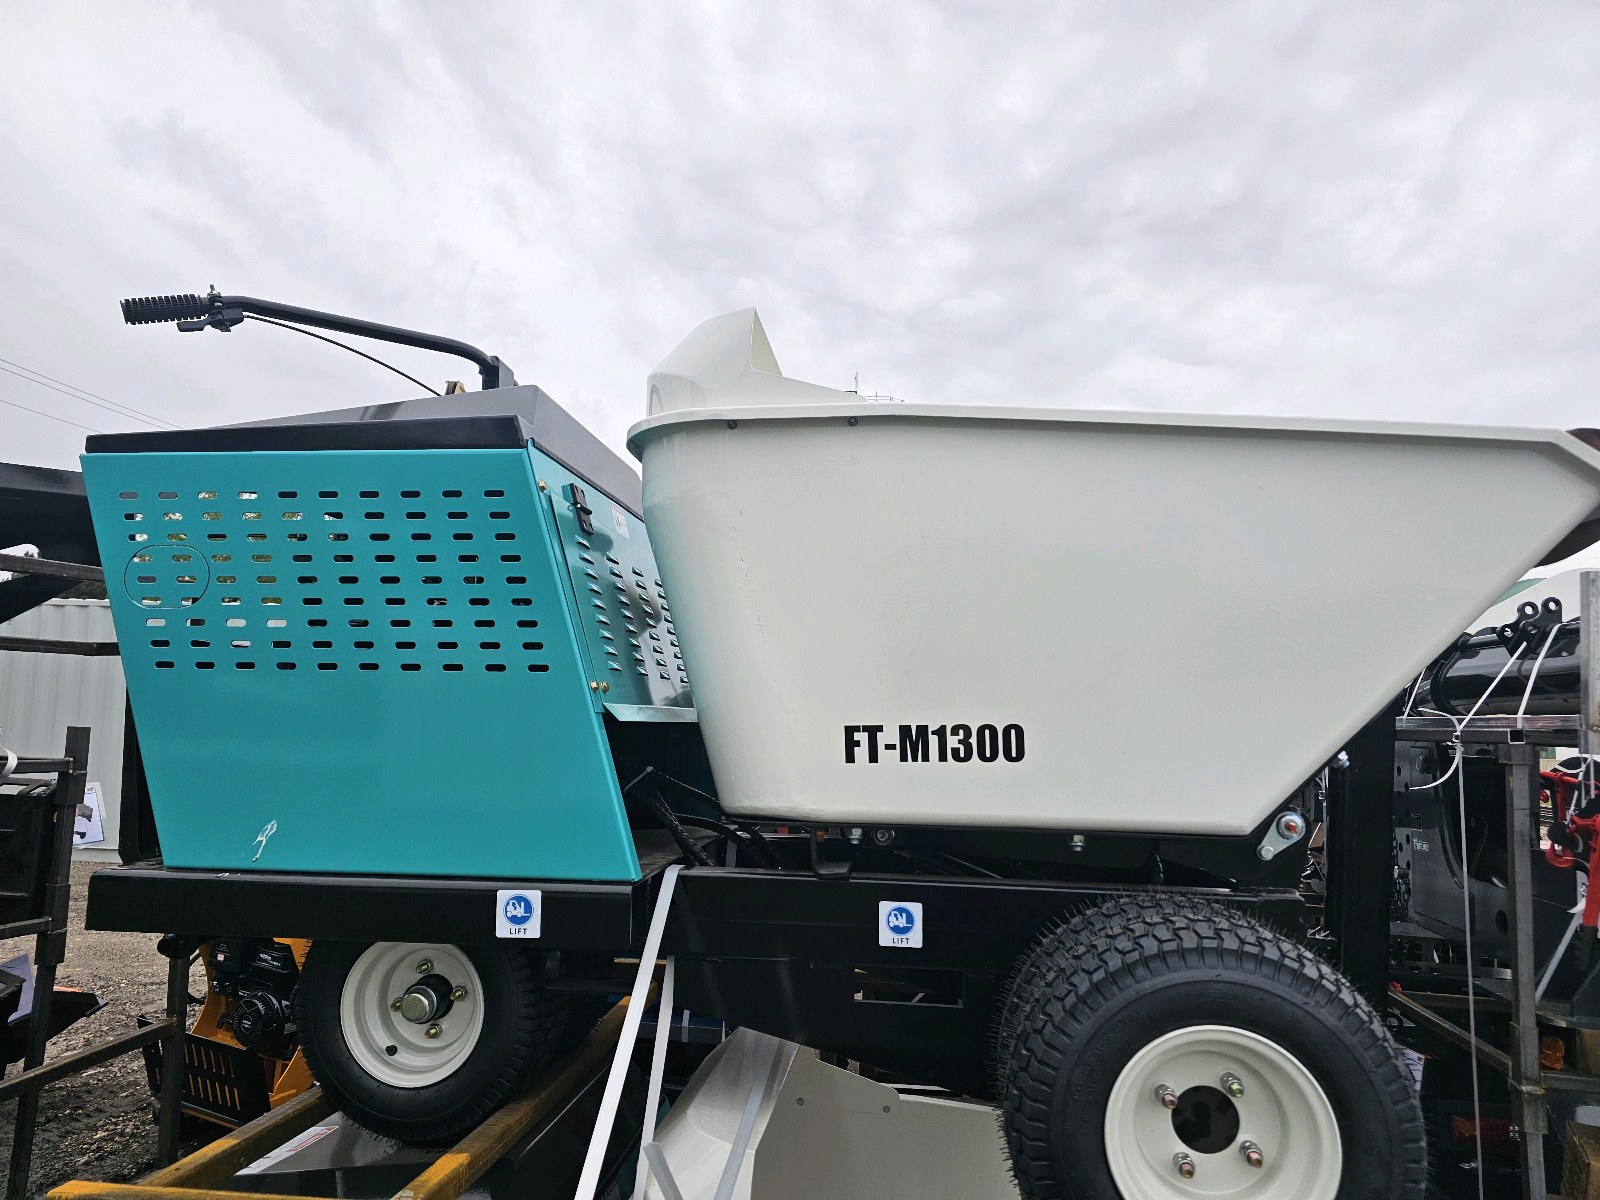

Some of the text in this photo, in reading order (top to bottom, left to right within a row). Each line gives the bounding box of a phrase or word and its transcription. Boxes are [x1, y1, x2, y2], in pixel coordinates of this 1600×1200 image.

[844, 723, 1025, 763] FT-M1300
[509, 927, 527, 935] LIFT
[892, 937, 910, 945] LIFT
